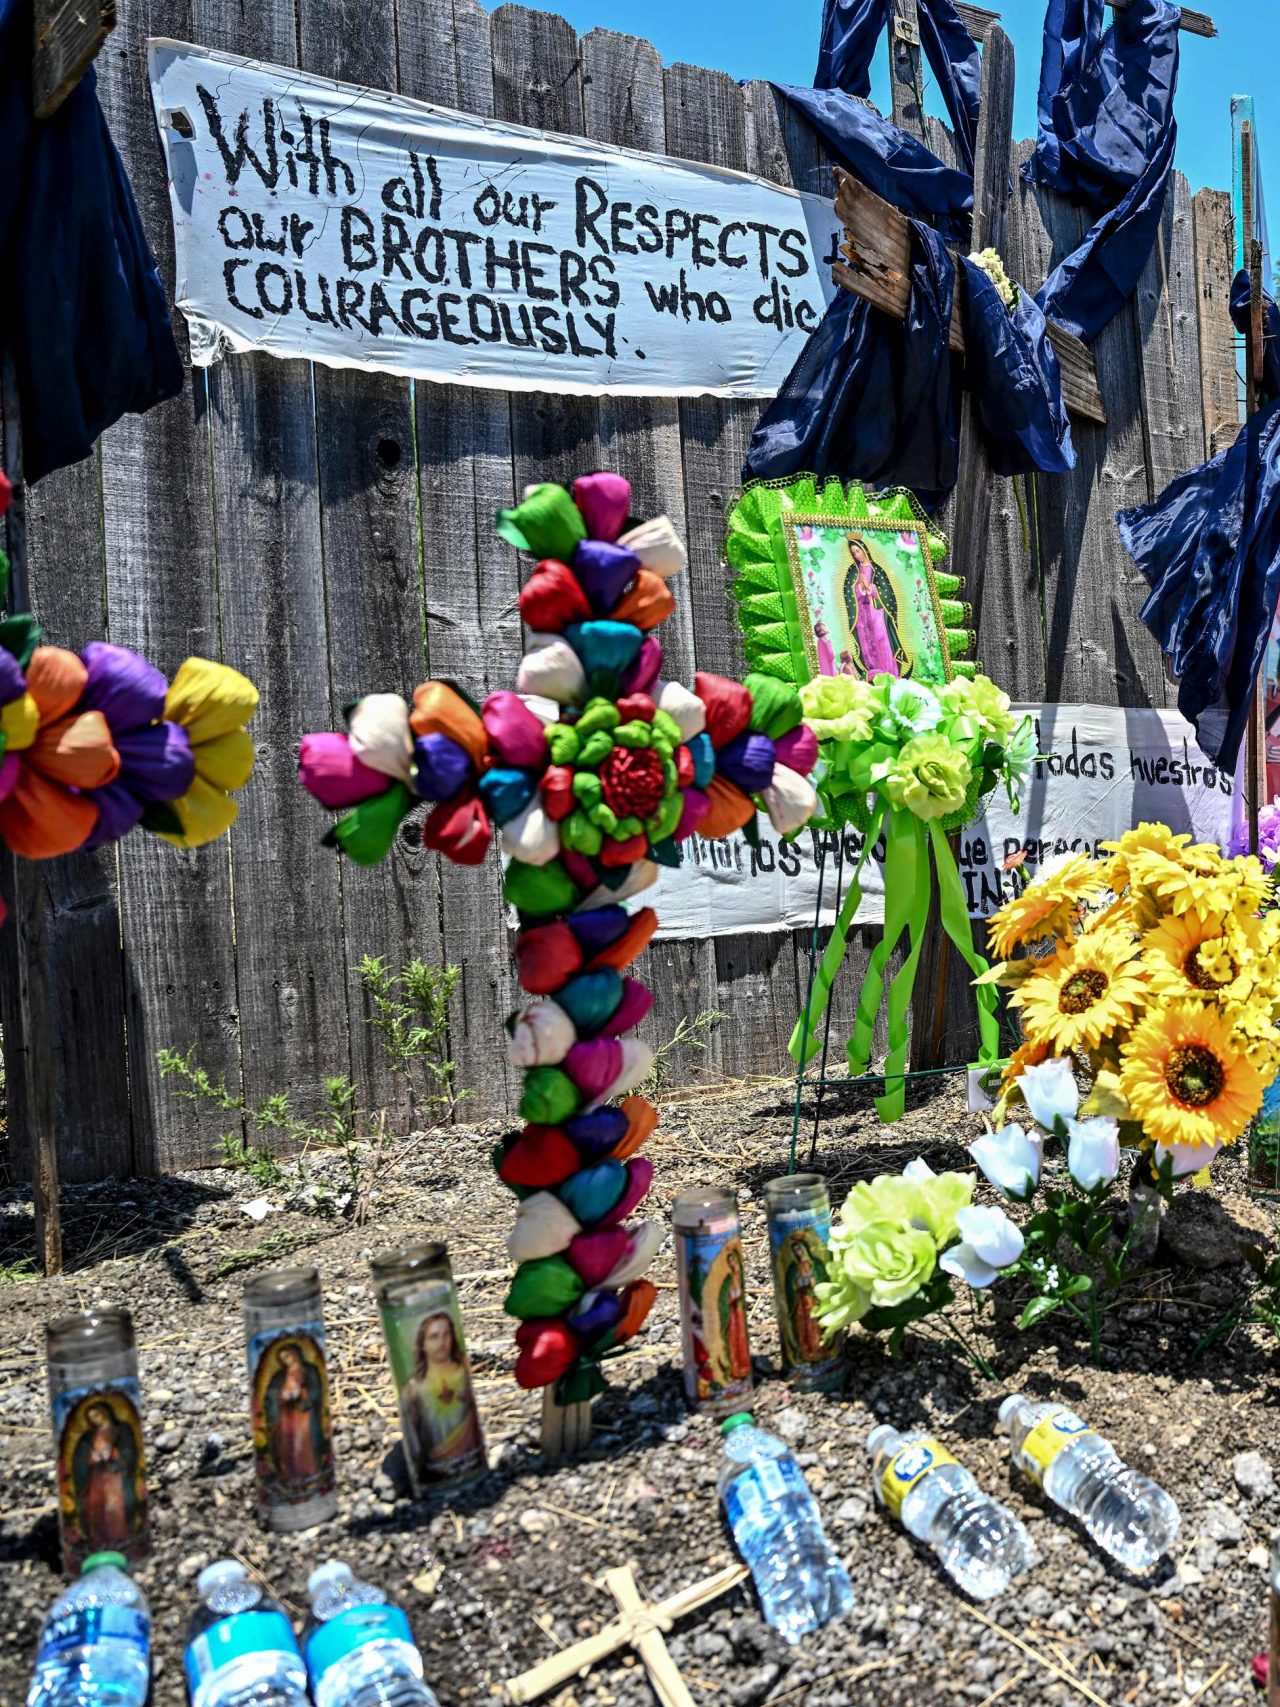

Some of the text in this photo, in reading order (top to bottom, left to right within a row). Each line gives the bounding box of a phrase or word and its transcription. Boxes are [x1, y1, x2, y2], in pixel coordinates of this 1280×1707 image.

[196, 83, 356, 197] With
[381, 151, 442, 220] all
[473, 184, 558, 235] our
[574, 176, 810, 282] RESPECTS
[217, 204, 818, 334] our BROTHERS who die
[222, 258, 647, 361] COURAGEOUSLY.
[1129, 735, 1235, 796] nuestros
